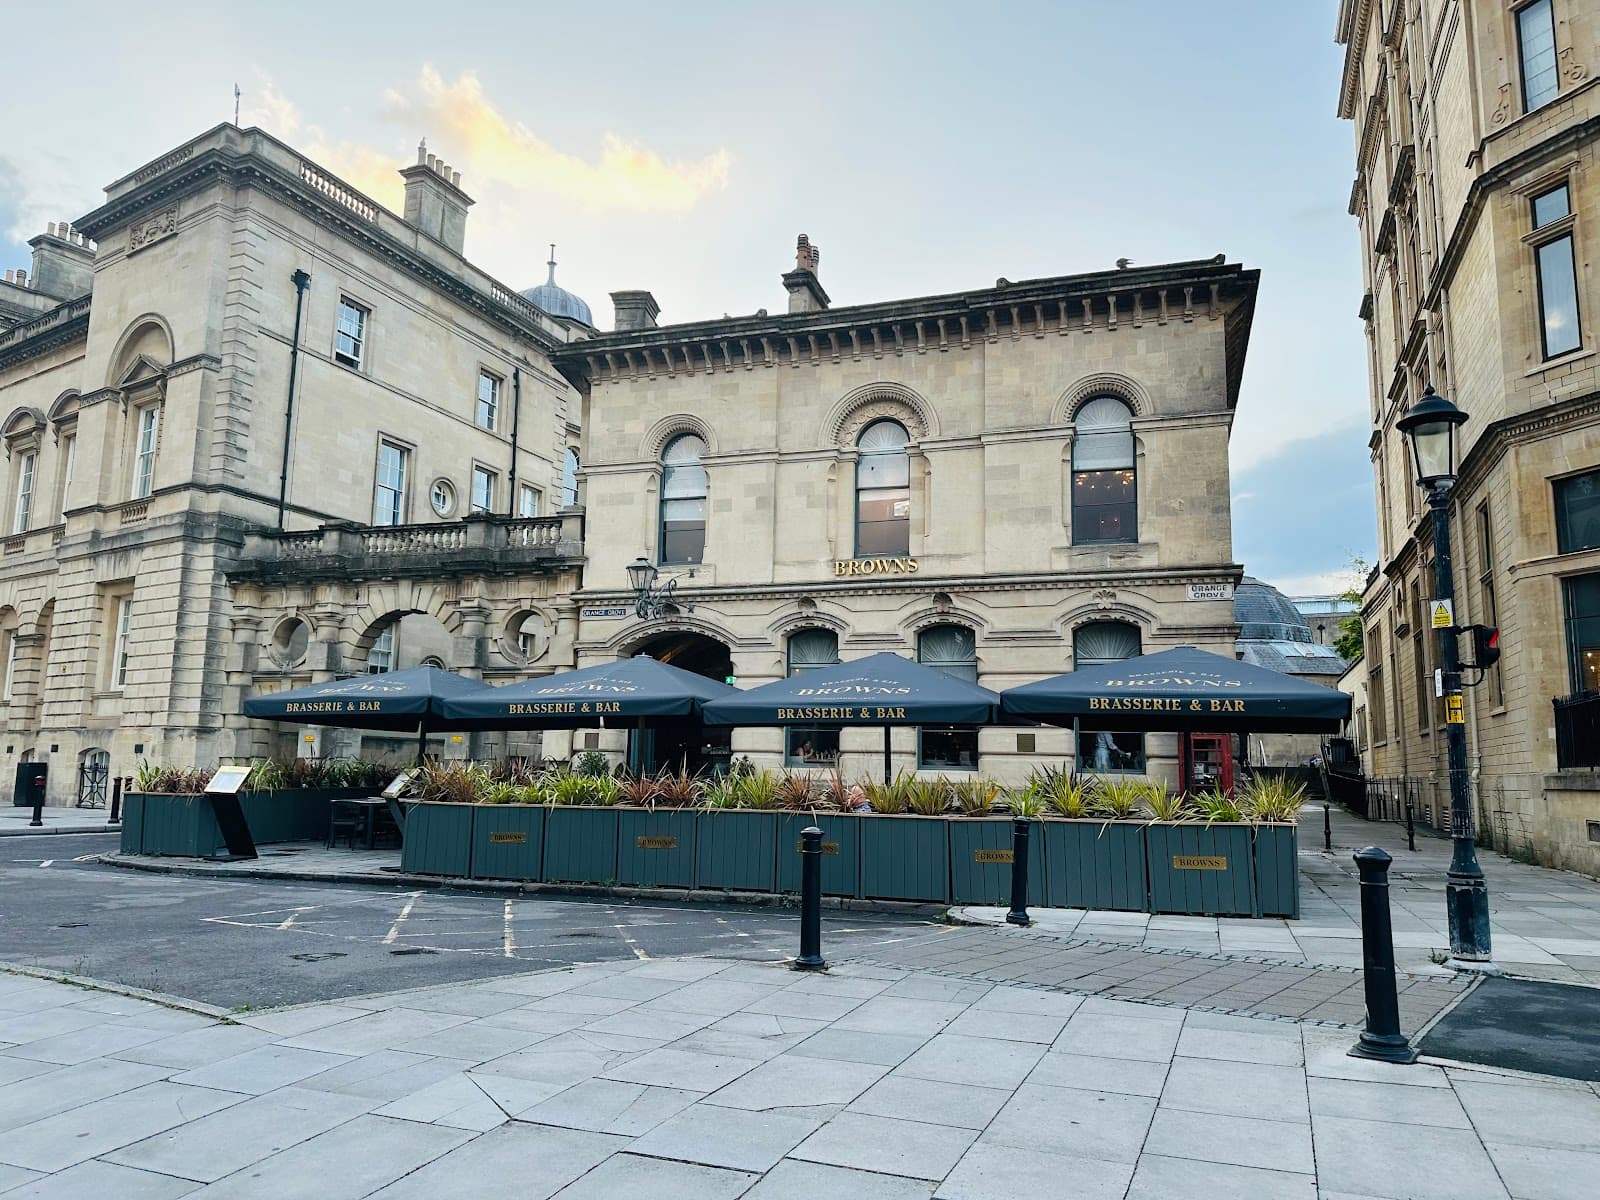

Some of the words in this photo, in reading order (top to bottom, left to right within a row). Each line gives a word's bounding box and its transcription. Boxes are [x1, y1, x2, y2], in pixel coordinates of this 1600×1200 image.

[834, 558, 918, 576] BROWNS
[1191, 584, 1228, 592] ORANGE
[1106, 677, 1242, 688] BROWNS
[797, 685, 912, 696] BROWNS
[286, 701, 343, 713] BRASSERIE
[346, 701, 355, 711] &
[359, 701, 381, 711] BAR
[508, 702, 576, 714] BRASSERIE
[580, 702, 591, 713] &
[595, 701, 621, 712] BAR
[1089, 697, 1182, 711] BRASSERIE
[1189, 699, 1202, 711] &
[1210, 699, 1245, 712] BAR
[777, 707, 854, 719] BRASSERIE
[859, 707, 871, 719] &
[876, 707, 906, 719] BAR
[1179, 858, 1221, 867] BROWNS
